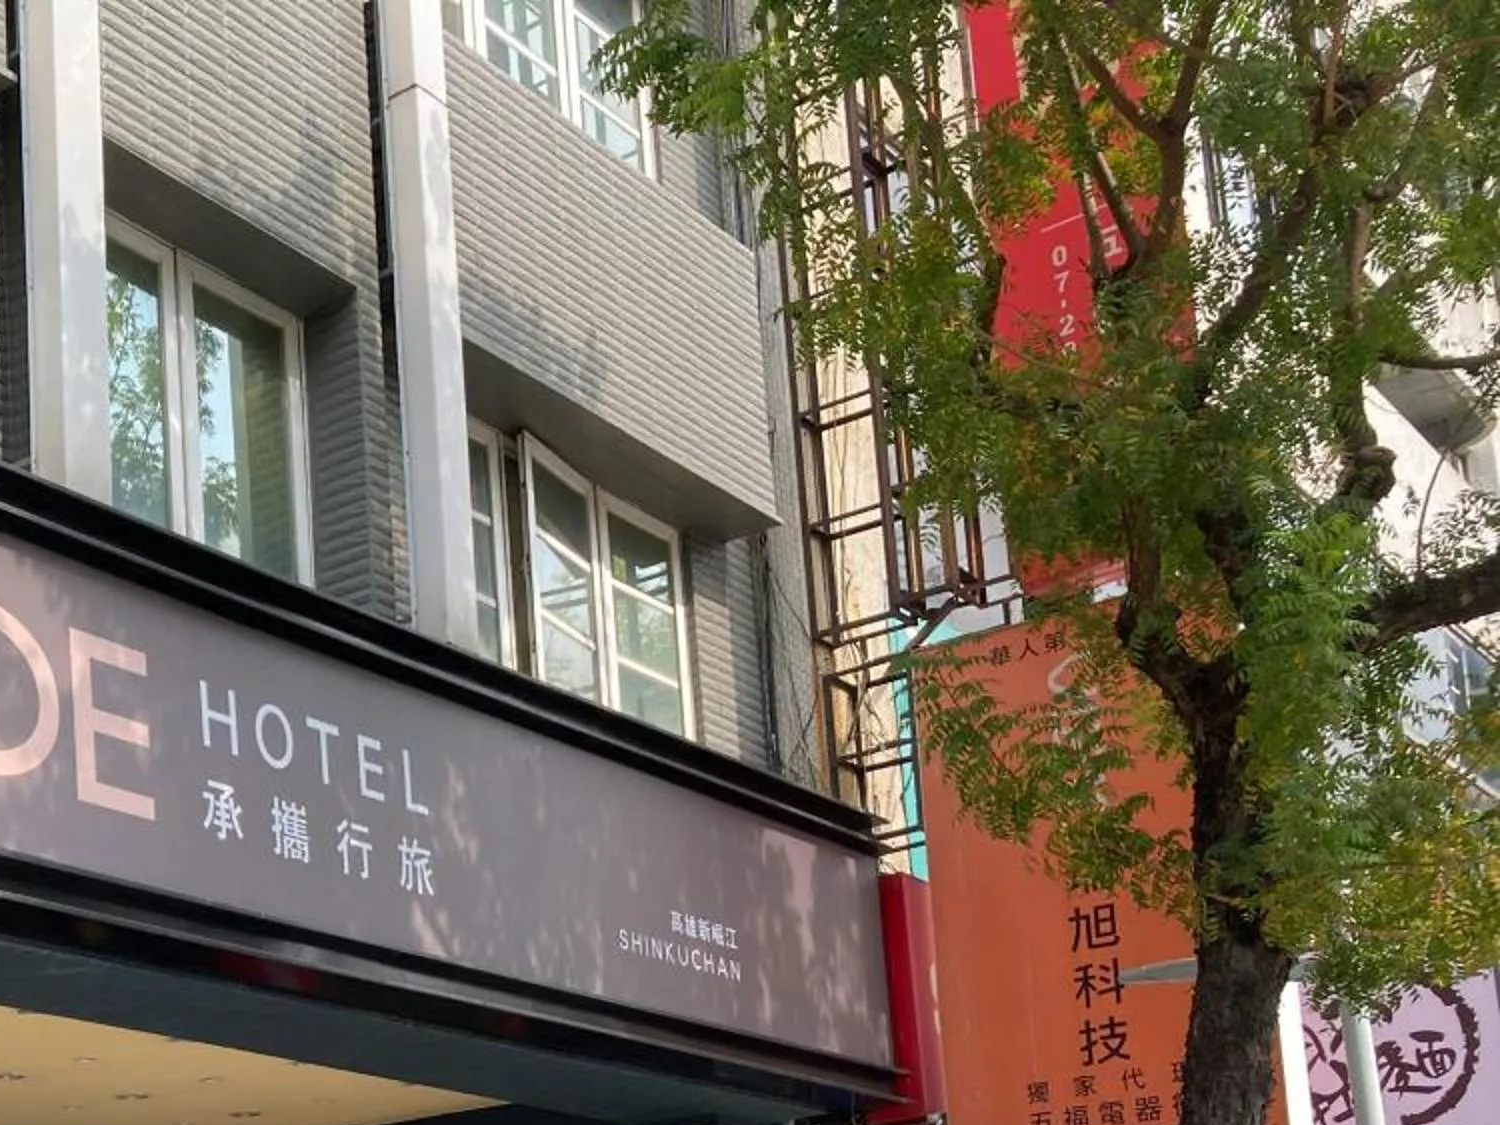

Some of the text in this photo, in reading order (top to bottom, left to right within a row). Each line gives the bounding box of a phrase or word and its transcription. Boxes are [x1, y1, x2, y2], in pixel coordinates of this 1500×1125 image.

[199, 679, 430, 817] HOTEL
[201, 778, 435, 897] 承攜行旅
[618, 928, 742, 982] SHINKUCHAN
[1067, 880, 1131, 1067] 旭科技
